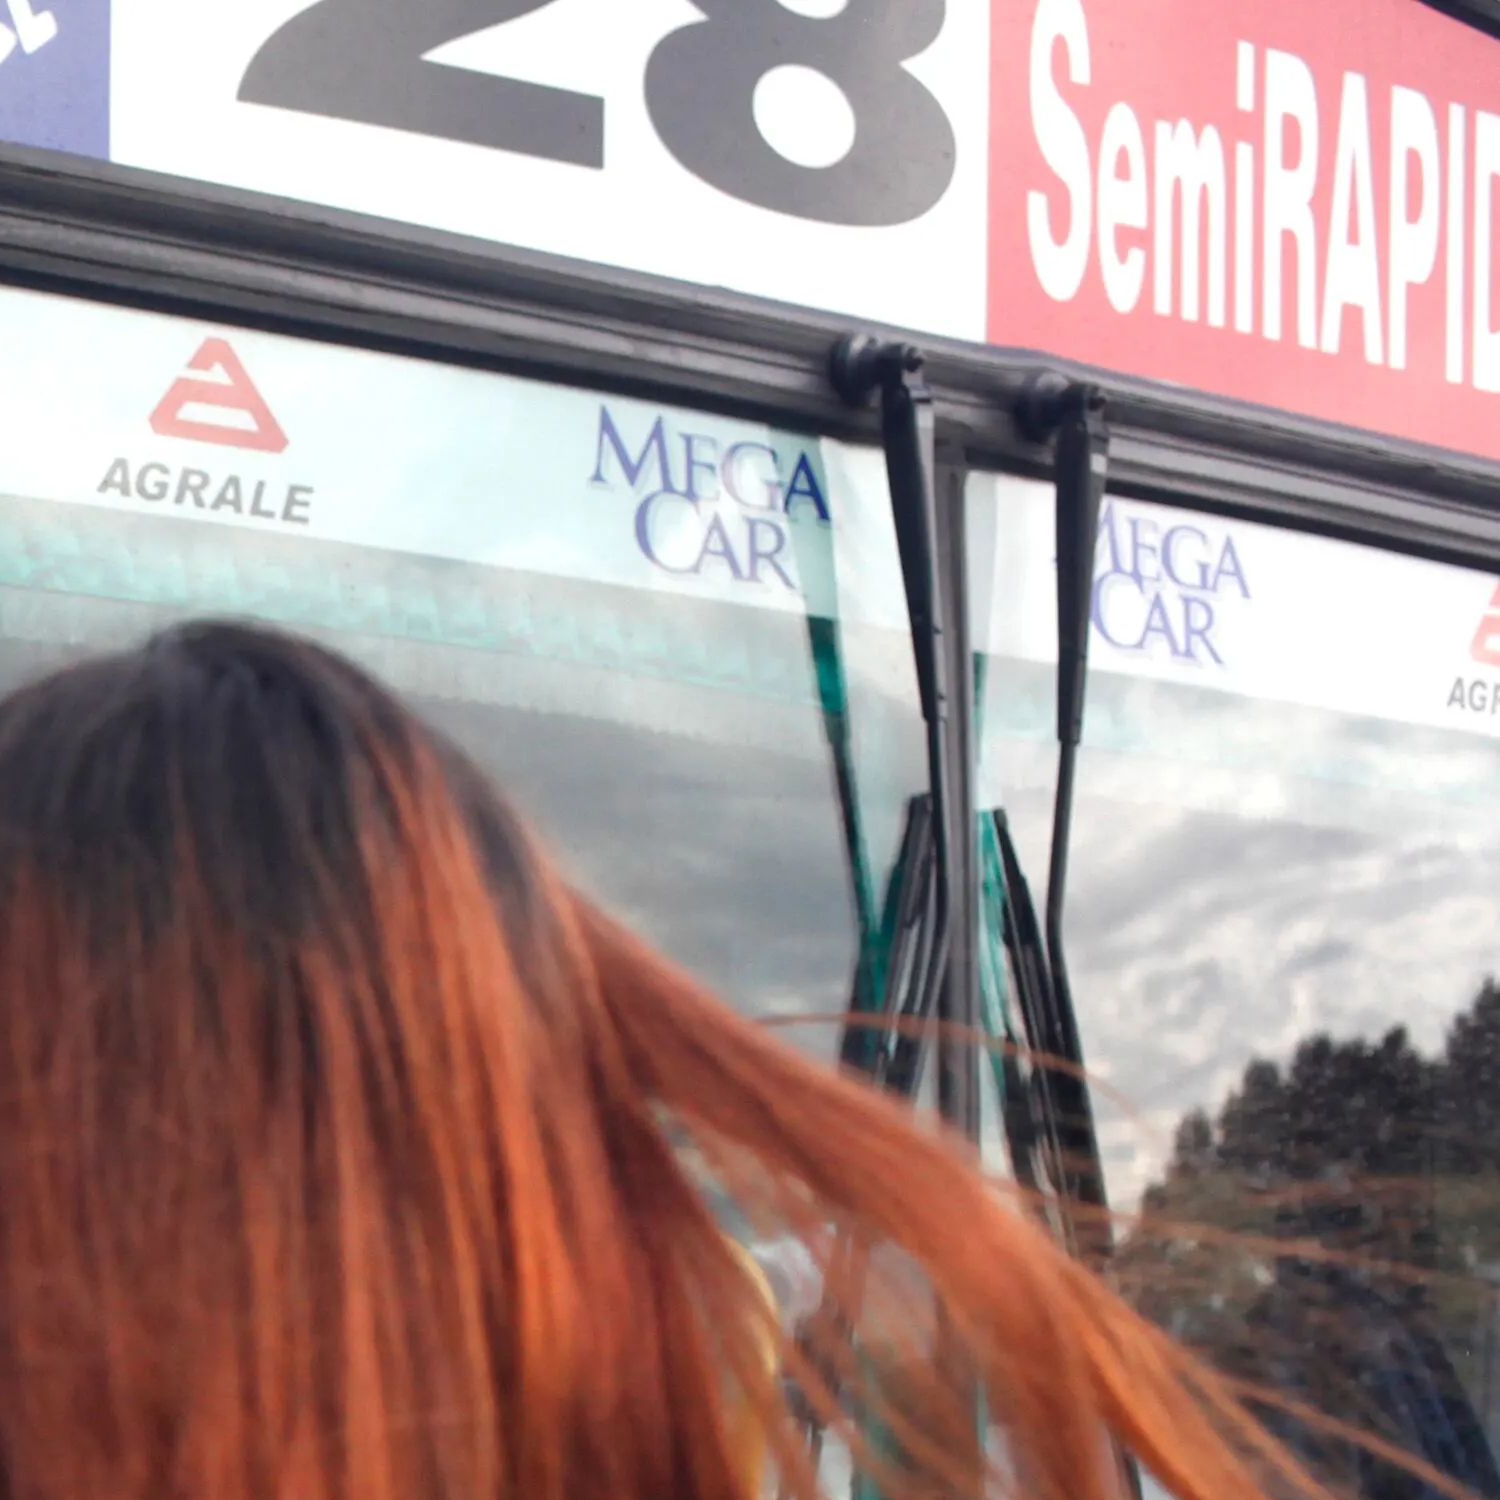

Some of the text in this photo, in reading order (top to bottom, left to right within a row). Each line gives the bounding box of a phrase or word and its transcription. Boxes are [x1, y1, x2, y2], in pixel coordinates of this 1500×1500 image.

[96, 456, 316, 526] AGRALE
[590, 403, 831, 523] MEGA
[634, 488, 797, 590] CAR
[1090, 569, 1227, 666] CAR
